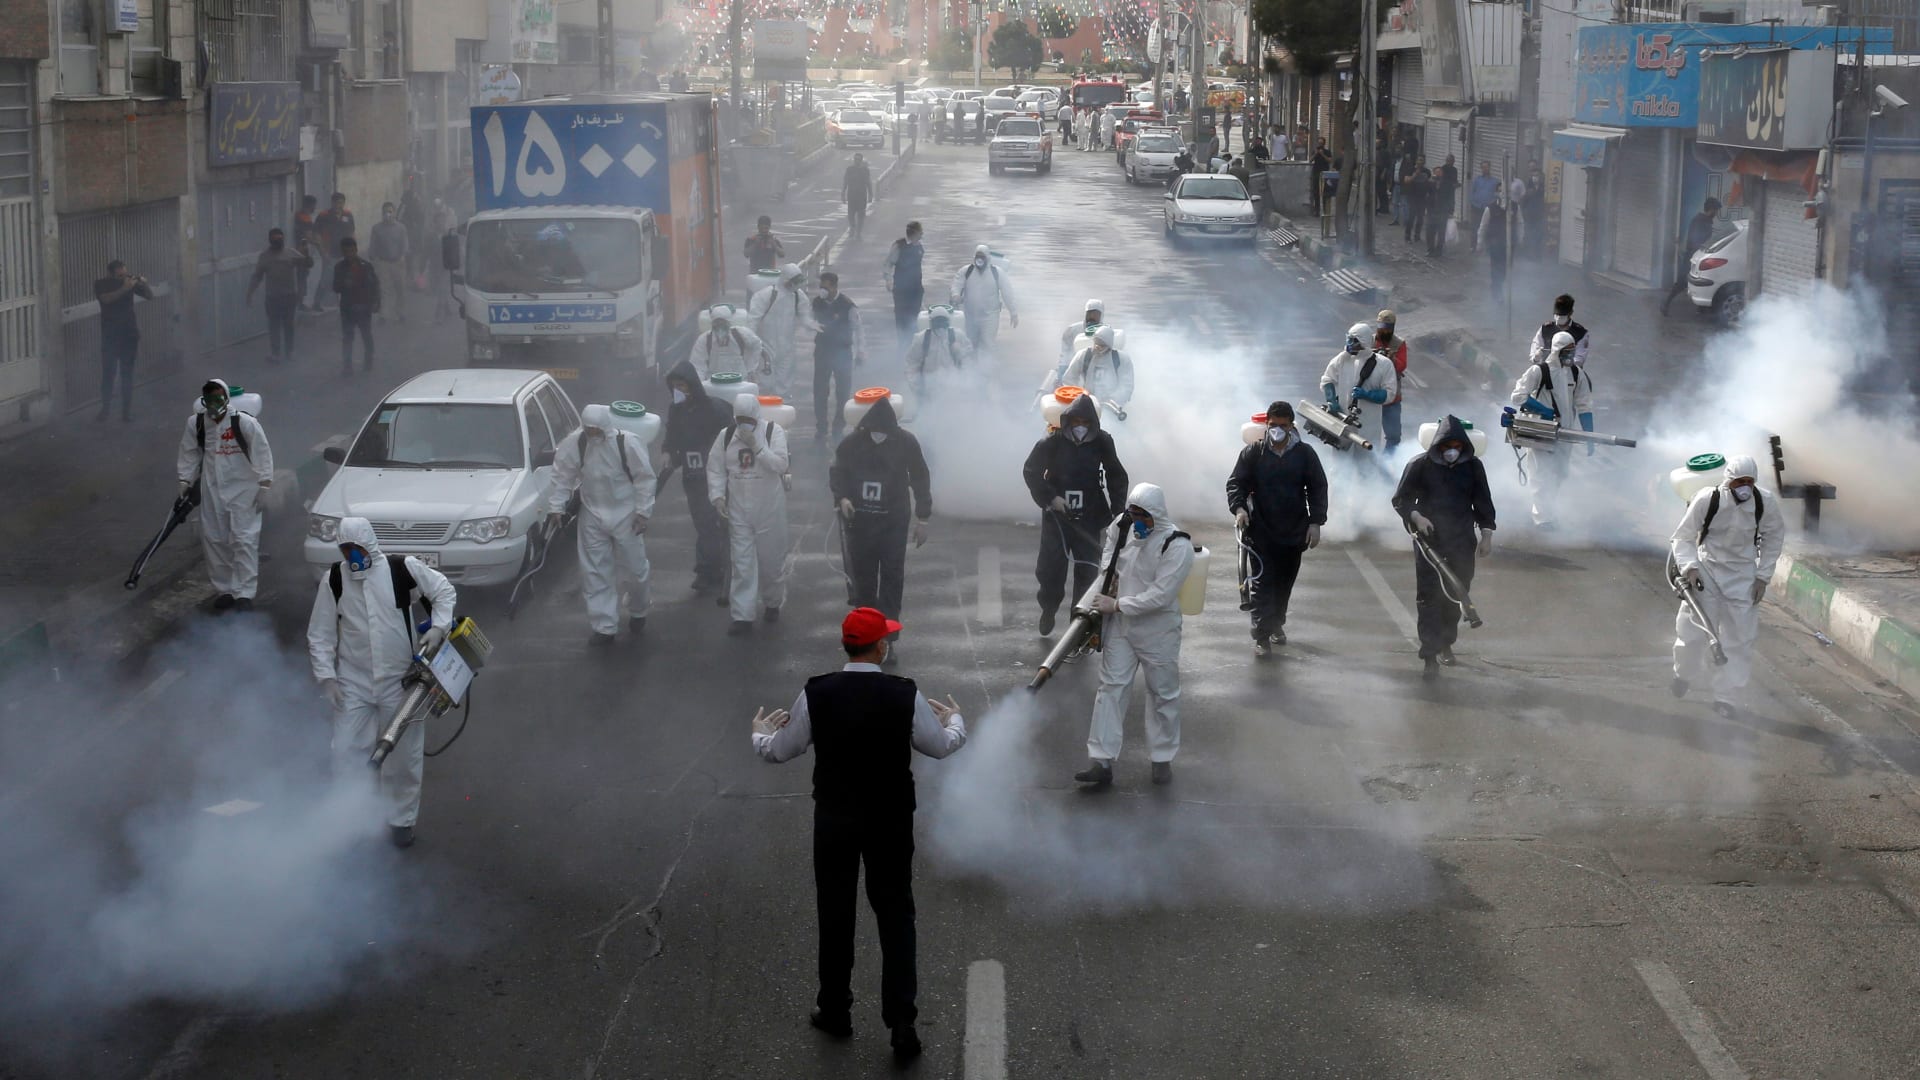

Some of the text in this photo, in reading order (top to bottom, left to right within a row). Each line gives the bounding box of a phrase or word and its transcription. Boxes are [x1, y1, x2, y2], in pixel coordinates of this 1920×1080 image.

[1636, 35, 1685, 77] نیکتا
[1632, 95, 1680, 117] nikta
[1746, 57, 1788, 141] باران
[571, 112, 624, 129] ظریف بار
[483, 110, 657, 197] ۱۵۰۰
[490, 305, 613, 321] ظریف بار ۱۵۰۰
